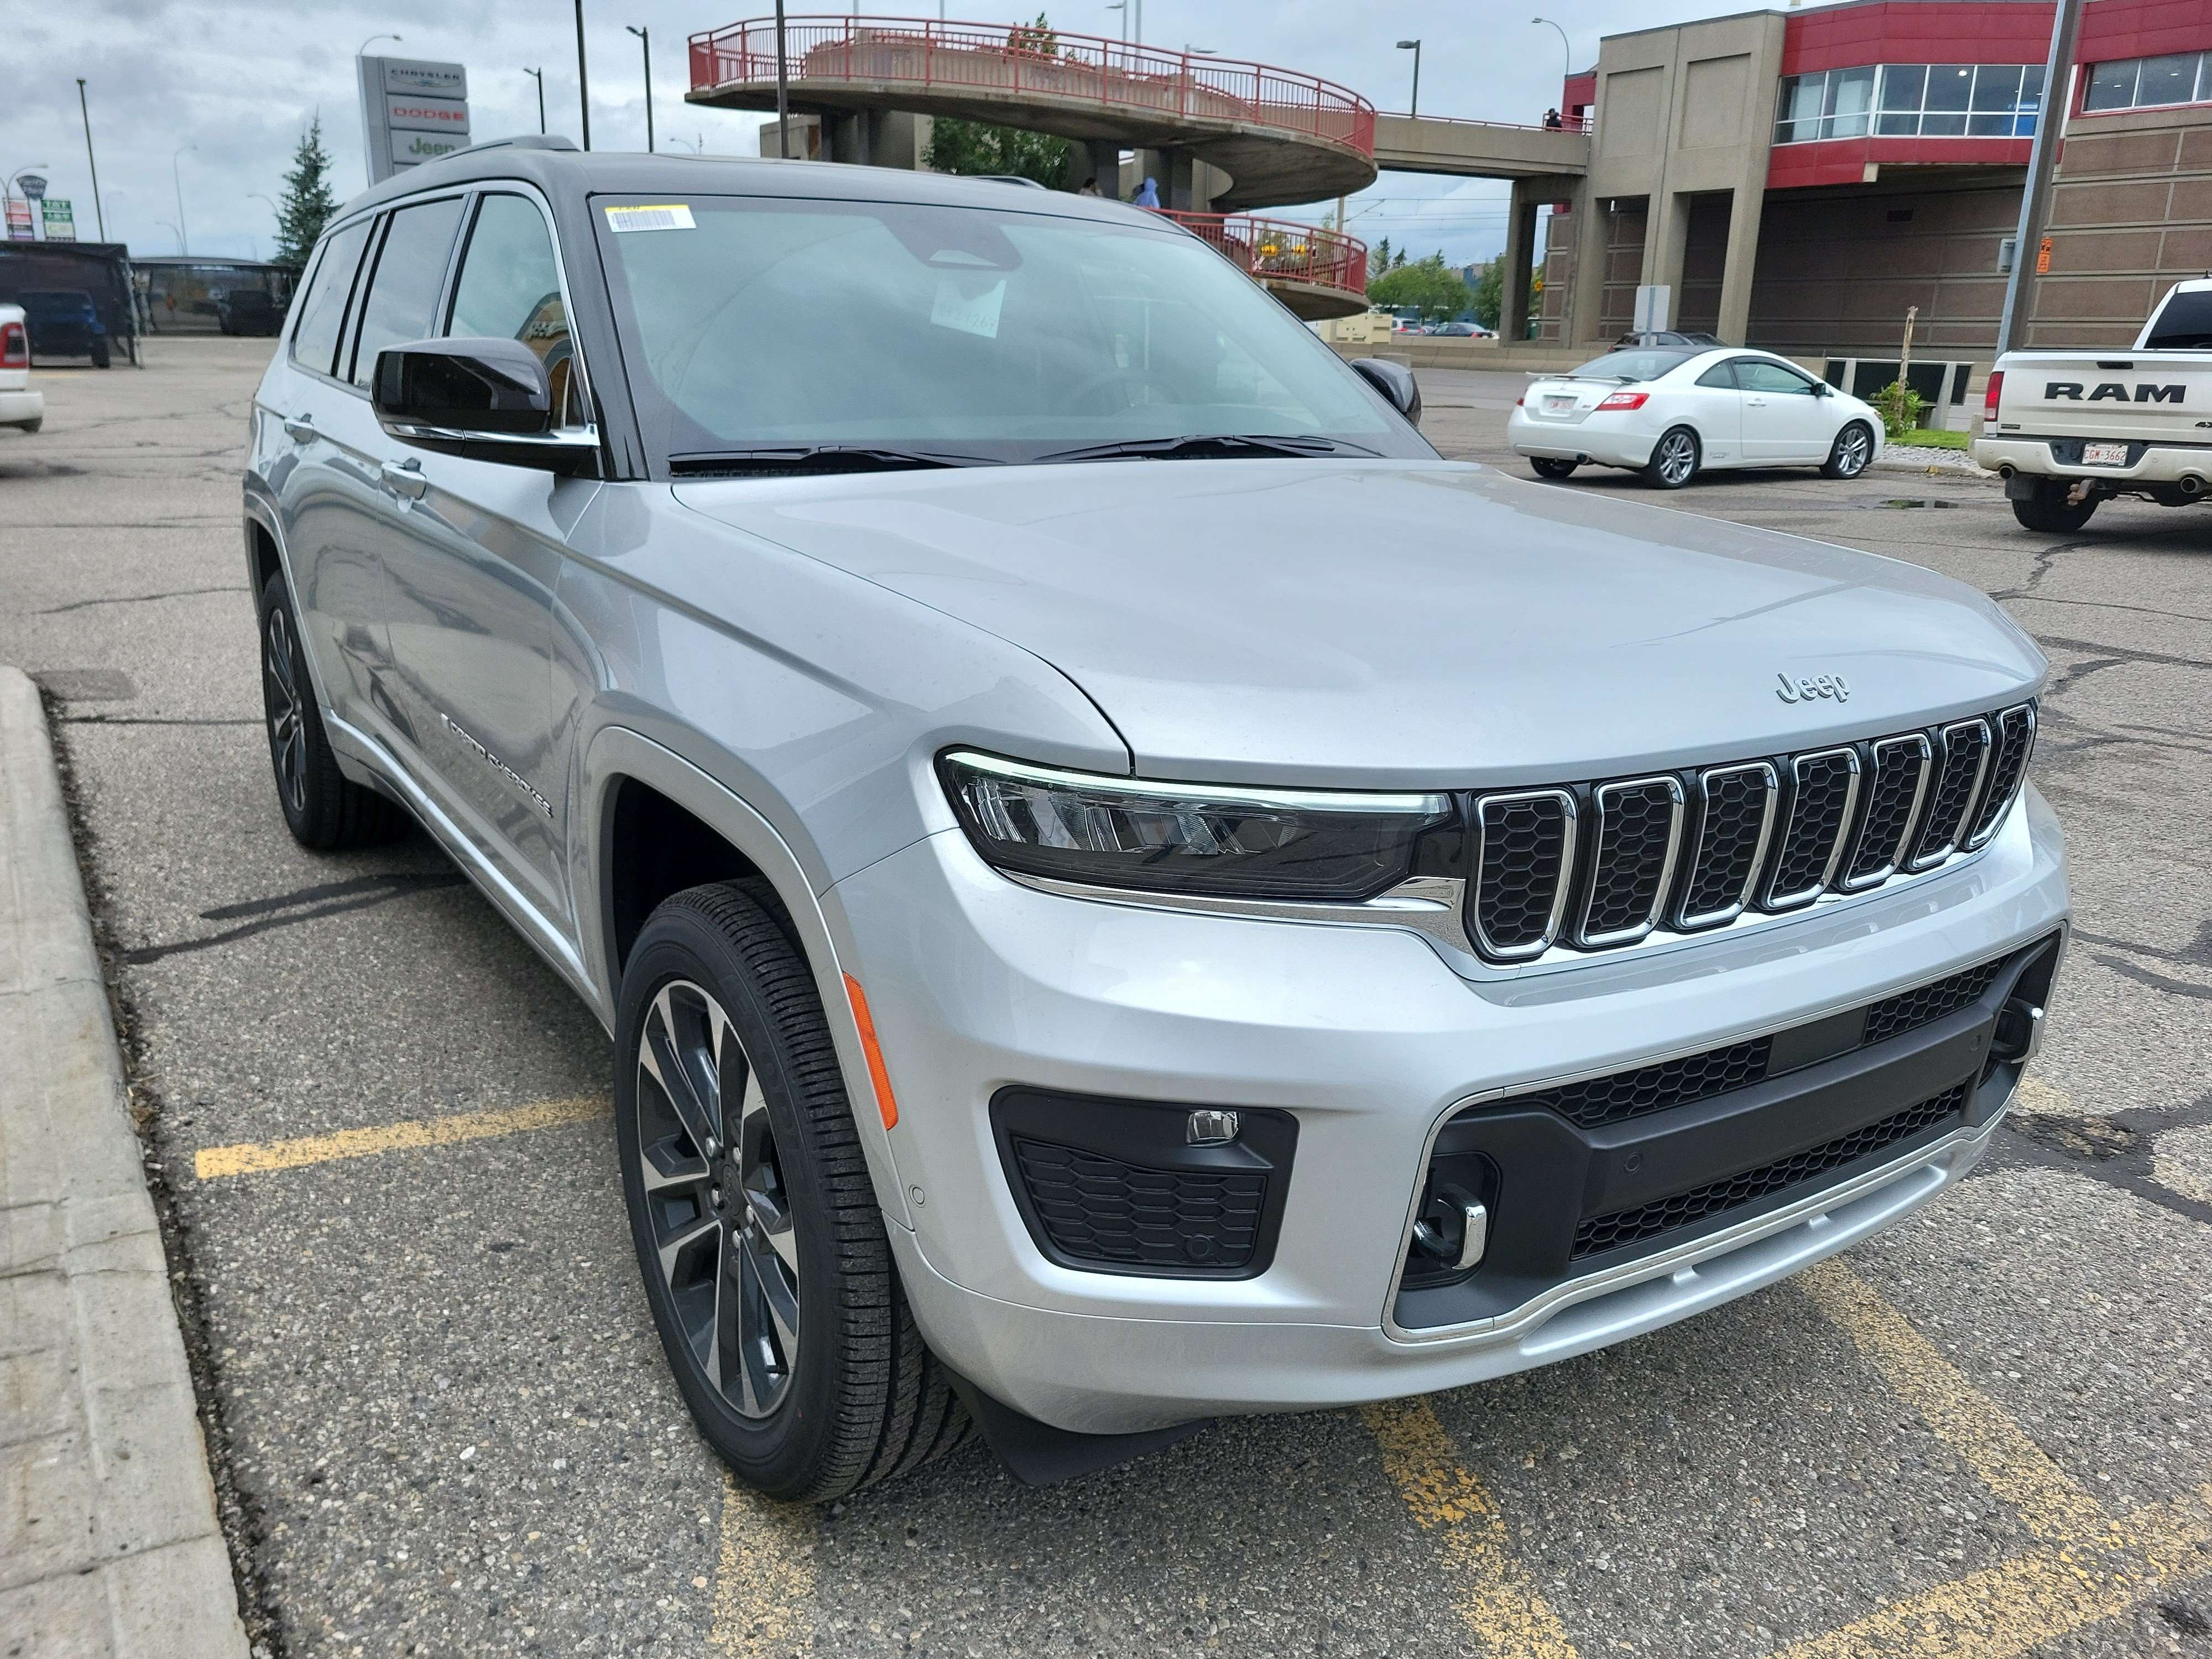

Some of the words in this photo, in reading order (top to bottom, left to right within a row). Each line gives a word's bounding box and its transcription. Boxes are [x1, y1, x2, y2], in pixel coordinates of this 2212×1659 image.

[391, 69, 460, 81] CHRYSLER
[394, 106, 465, 121] DODGE
[2044, 382, 2187, 403] RAM
[1775, 672, 1850, 704] Jeep
